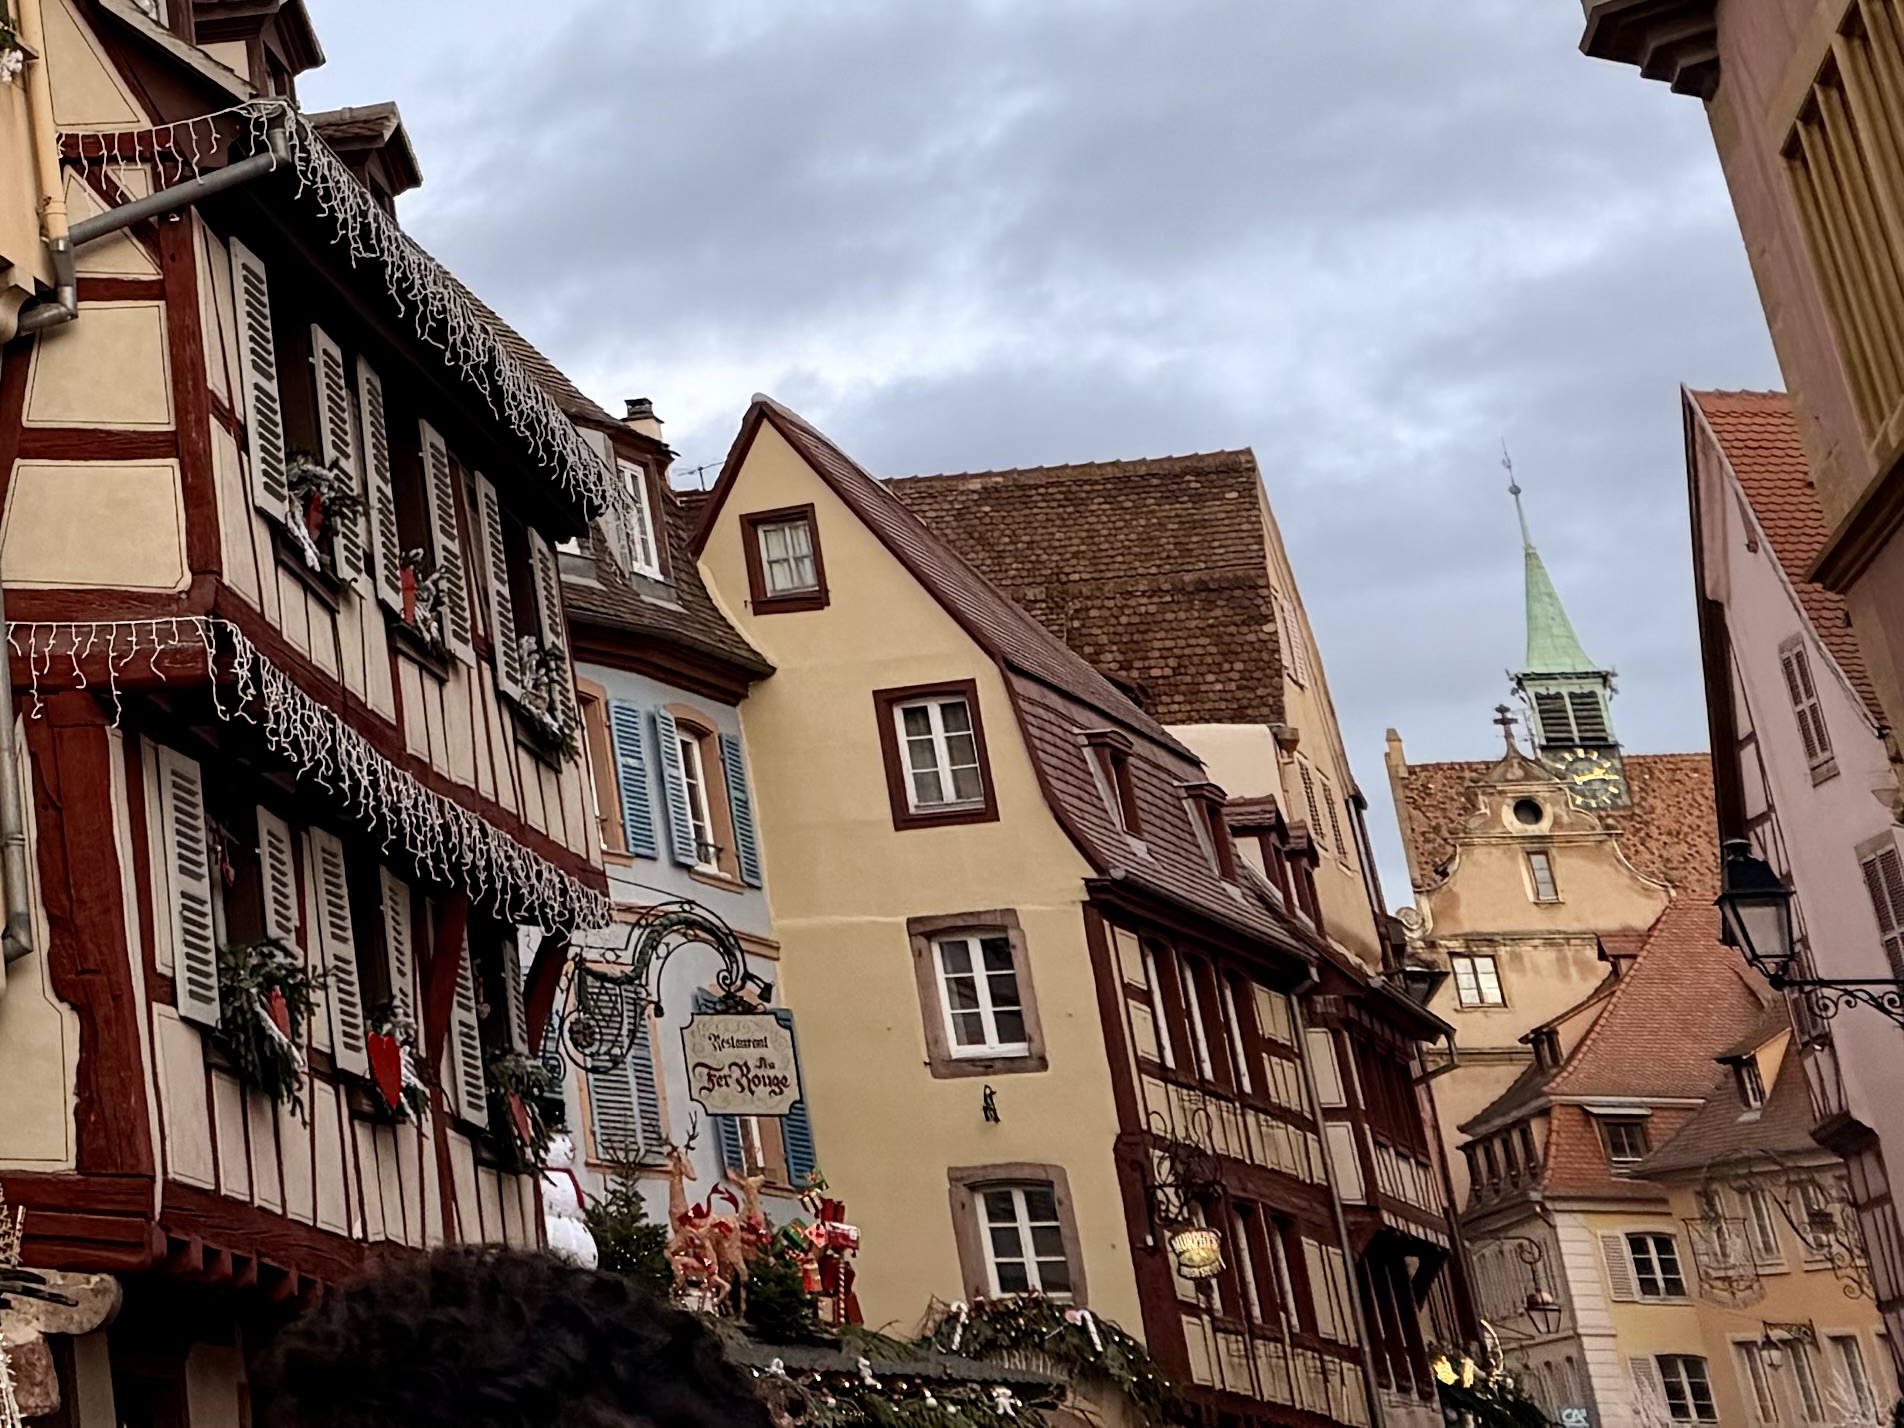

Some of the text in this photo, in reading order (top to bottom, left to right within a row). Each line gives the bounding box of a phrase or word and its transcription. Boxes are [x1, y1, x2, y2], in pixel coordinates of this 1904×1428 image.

[707, 1032, 769, 1051] Restaurant
[755, 1056, 776, 1070] Au
[692, 1060, 791, 1097] Fer Rouge
